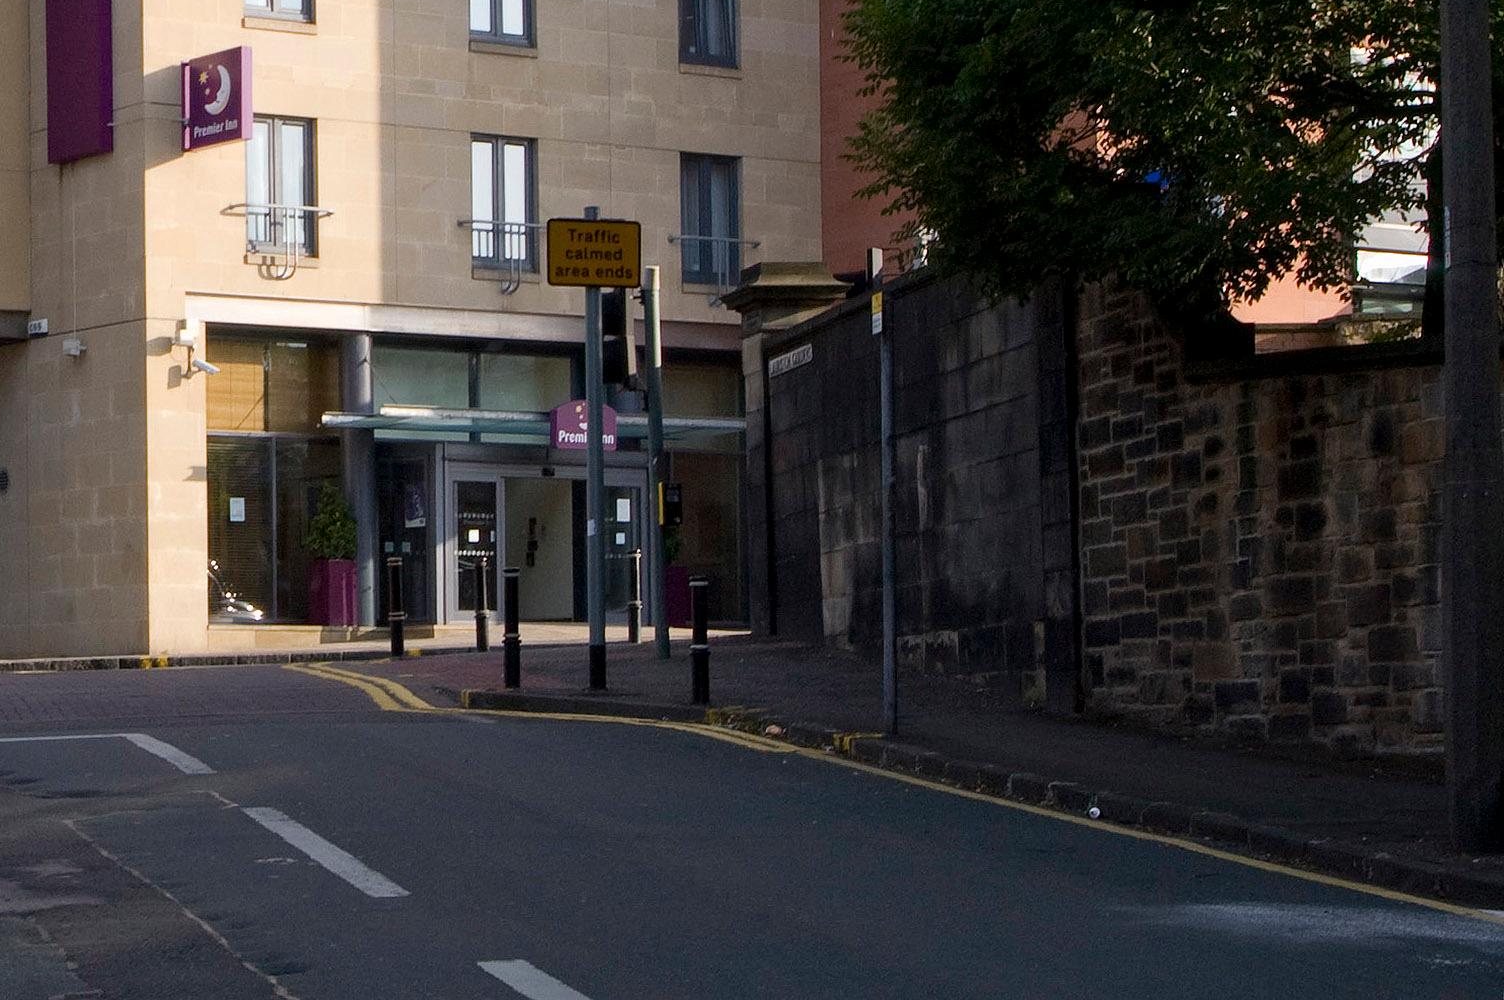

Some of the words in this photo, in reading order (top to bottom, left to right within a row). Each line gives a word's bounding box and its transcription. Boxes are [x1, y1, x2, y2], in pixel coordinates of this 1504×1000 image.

[194, 122, 223, 138] Premier
[225, 119, 237, 130] Inn
[568, 229, 620, 243] Traffic
[565, 247, 623, 261] calmed
[555, 265, 590, 278] area
[596, 265, 633, 279] ends
[558, 430, 588, 443] Premi
